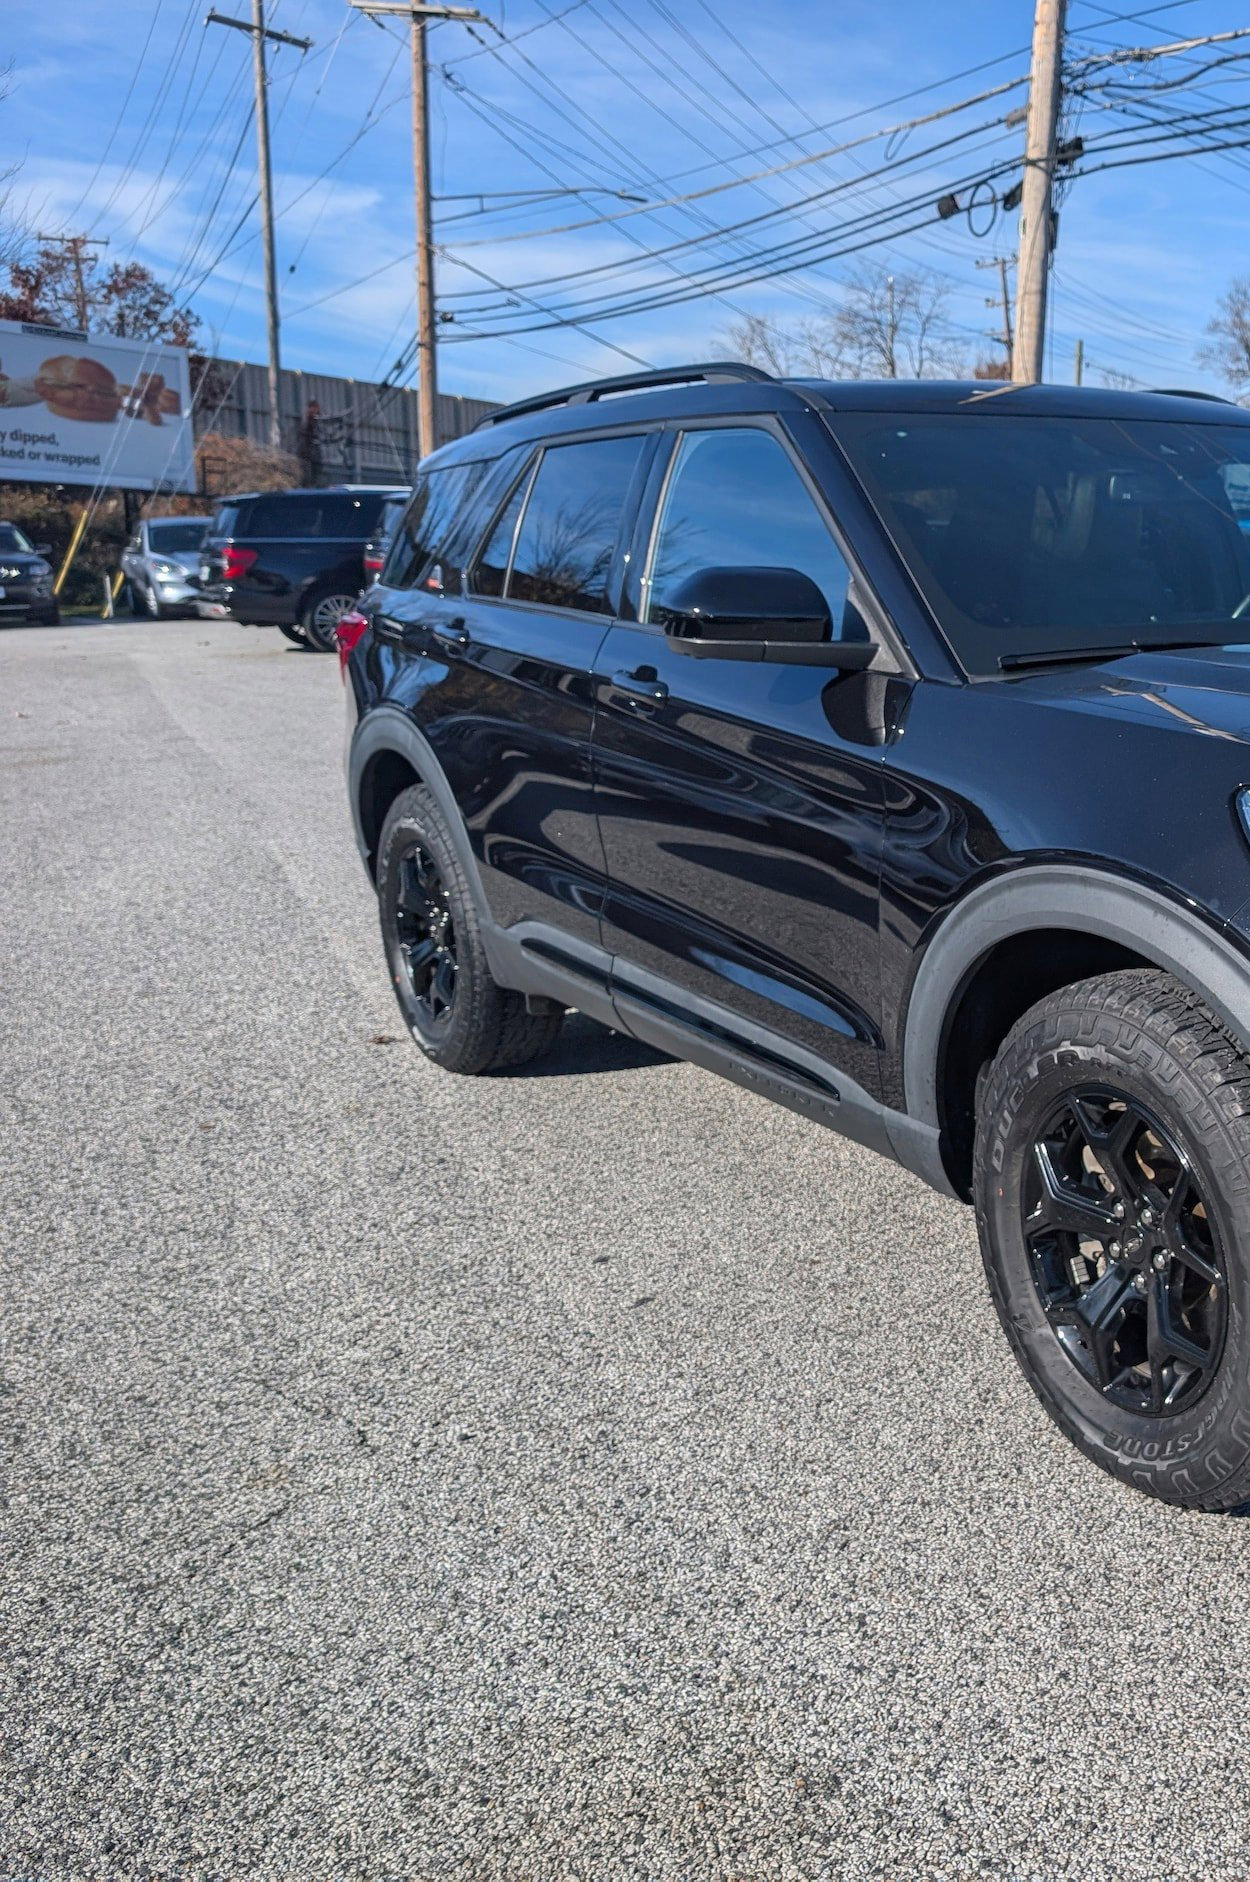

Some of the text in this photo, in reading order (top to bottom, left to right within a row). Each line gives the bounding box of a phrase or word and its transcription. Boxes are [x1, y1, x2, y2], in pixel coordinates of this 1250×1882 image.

[10, 428, 60, 447] dipped,
[28, 450, 41, 461] or
[44, 453, 101, 468] wrapped
